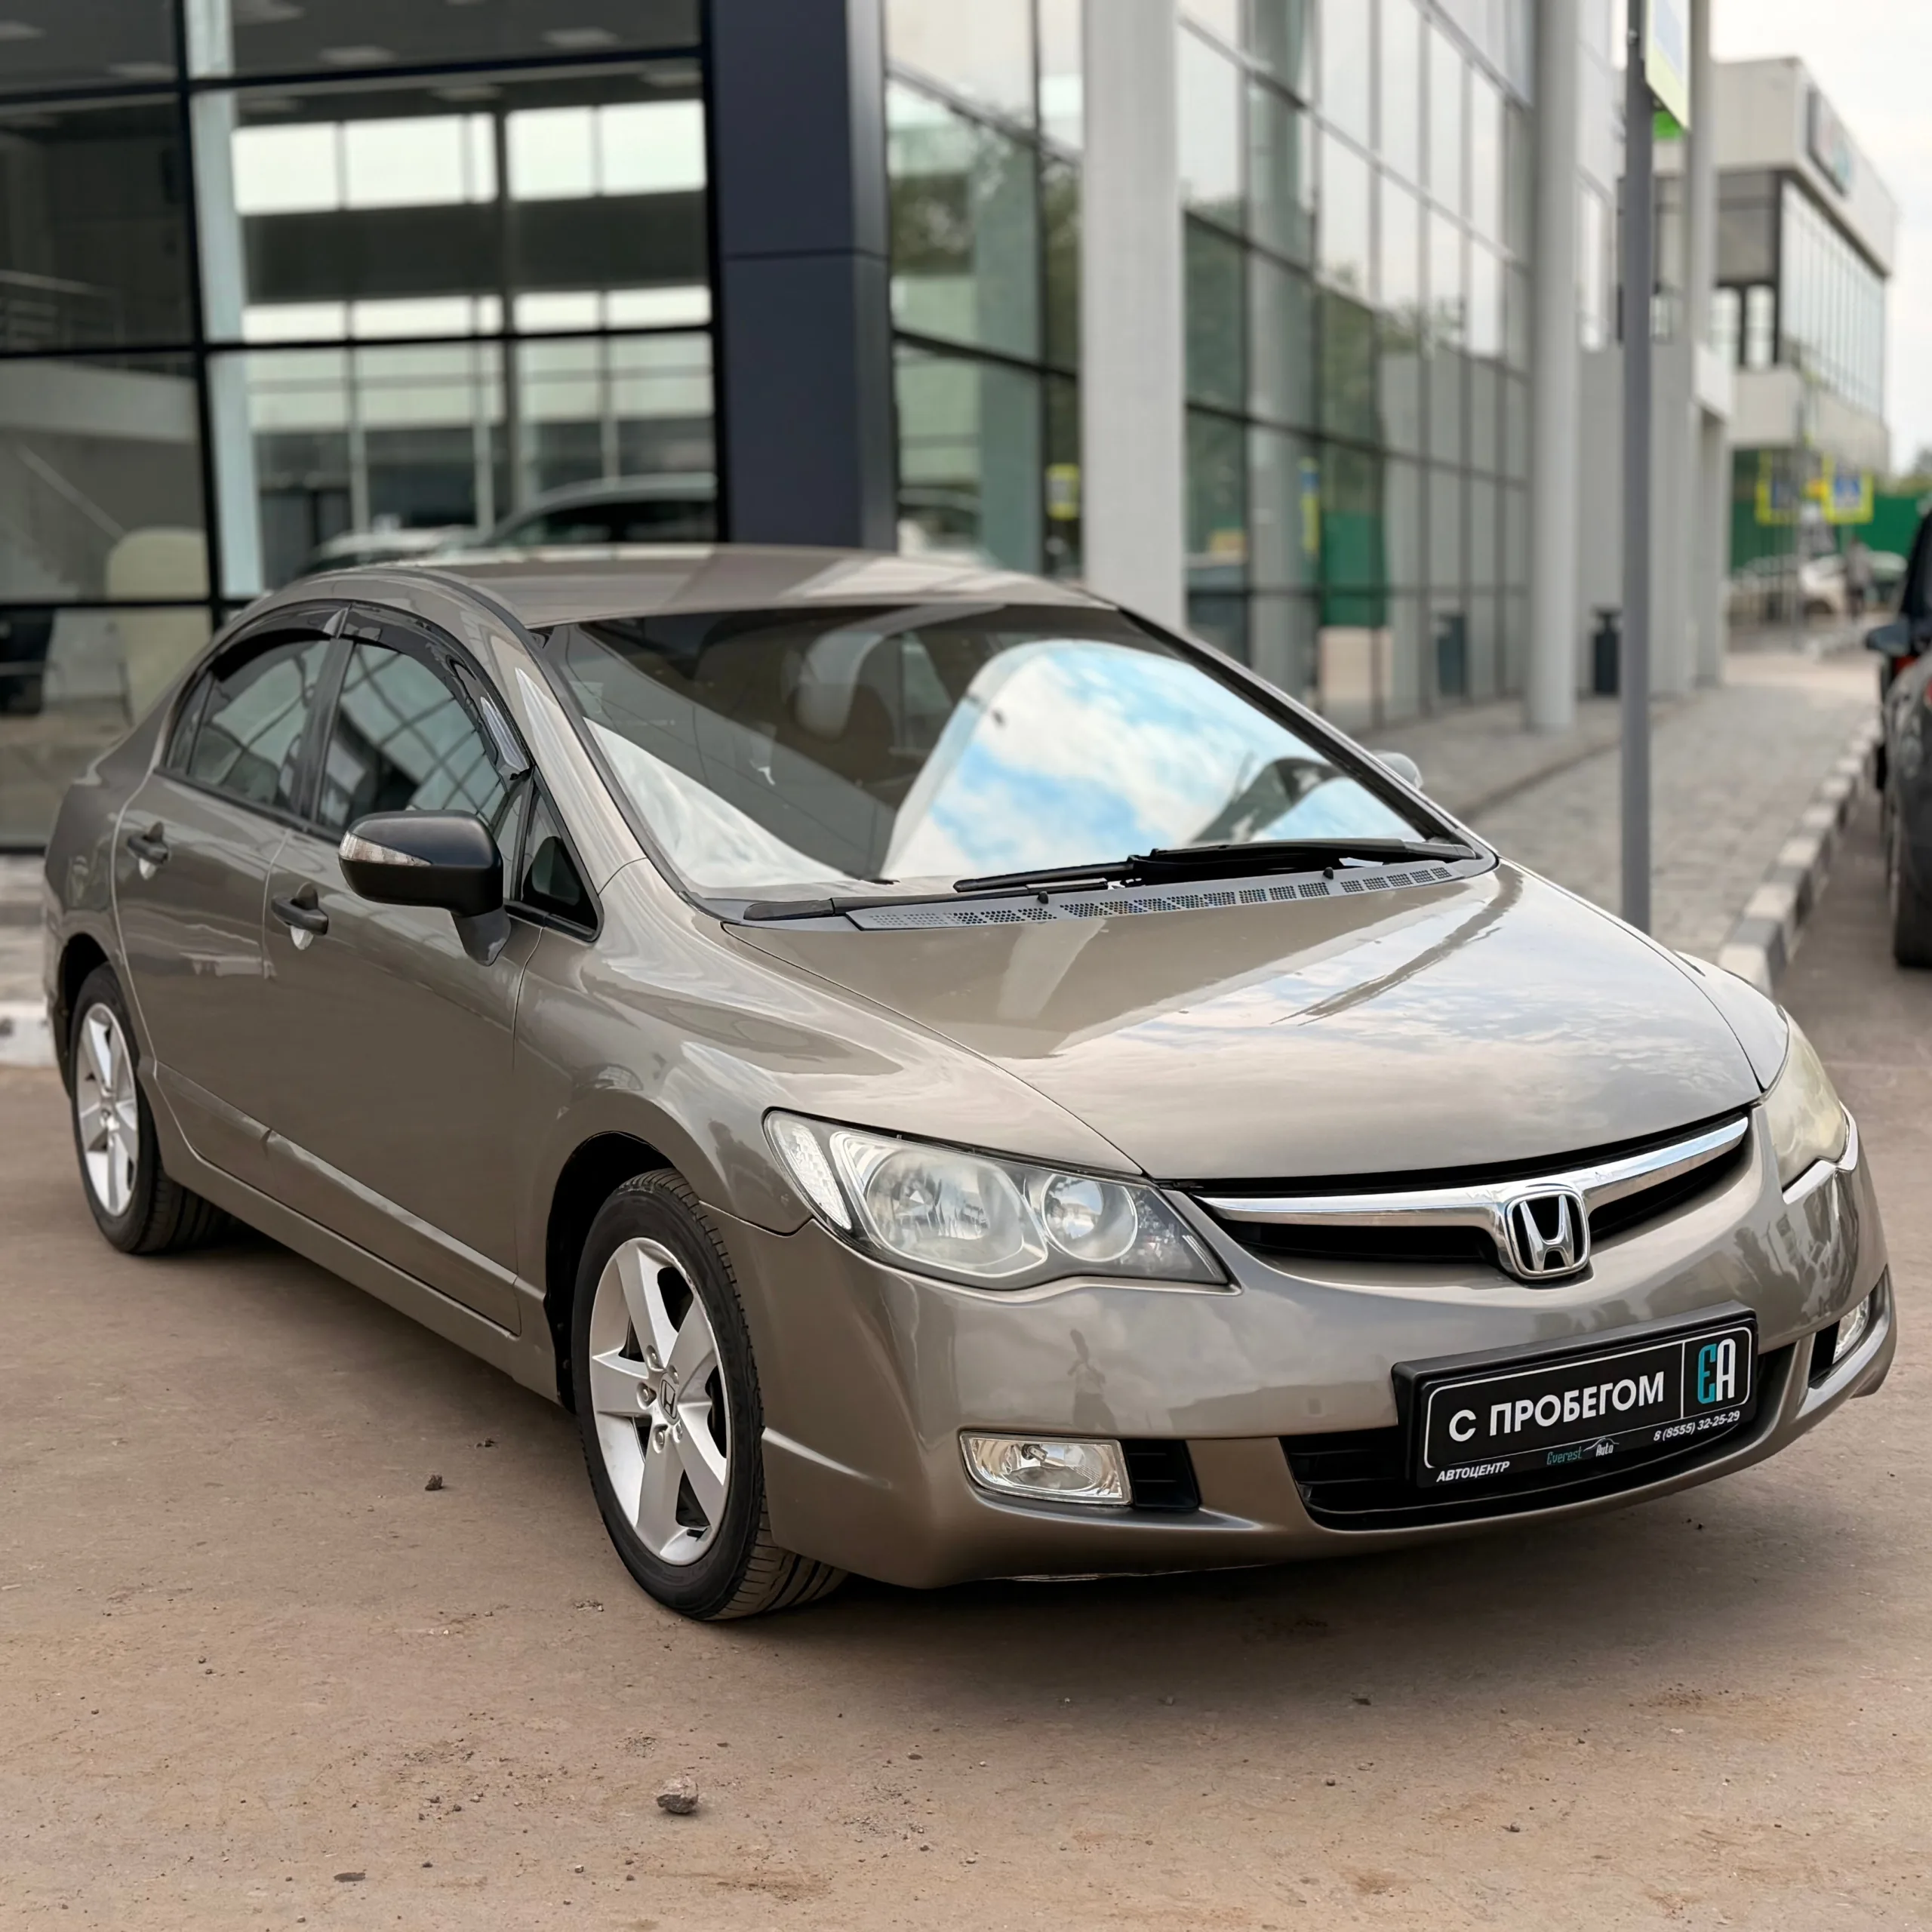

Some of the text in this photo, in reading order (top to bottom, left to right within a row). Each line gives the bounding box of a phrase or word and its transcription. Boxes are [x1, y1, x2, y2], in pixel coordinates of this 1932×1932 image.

[1697, 1338, 1736, 1404] EA
[1449, 1371, 1665, 1442] С ПРОБЕГОМ
[1653, 1411, 1741, 1441] 8 (8555) 32-25-29
[1546, 1442, 1614, 1466] Everest Auto
[1435, 1461, 1510, 1483] АВТОЦЕНТР
